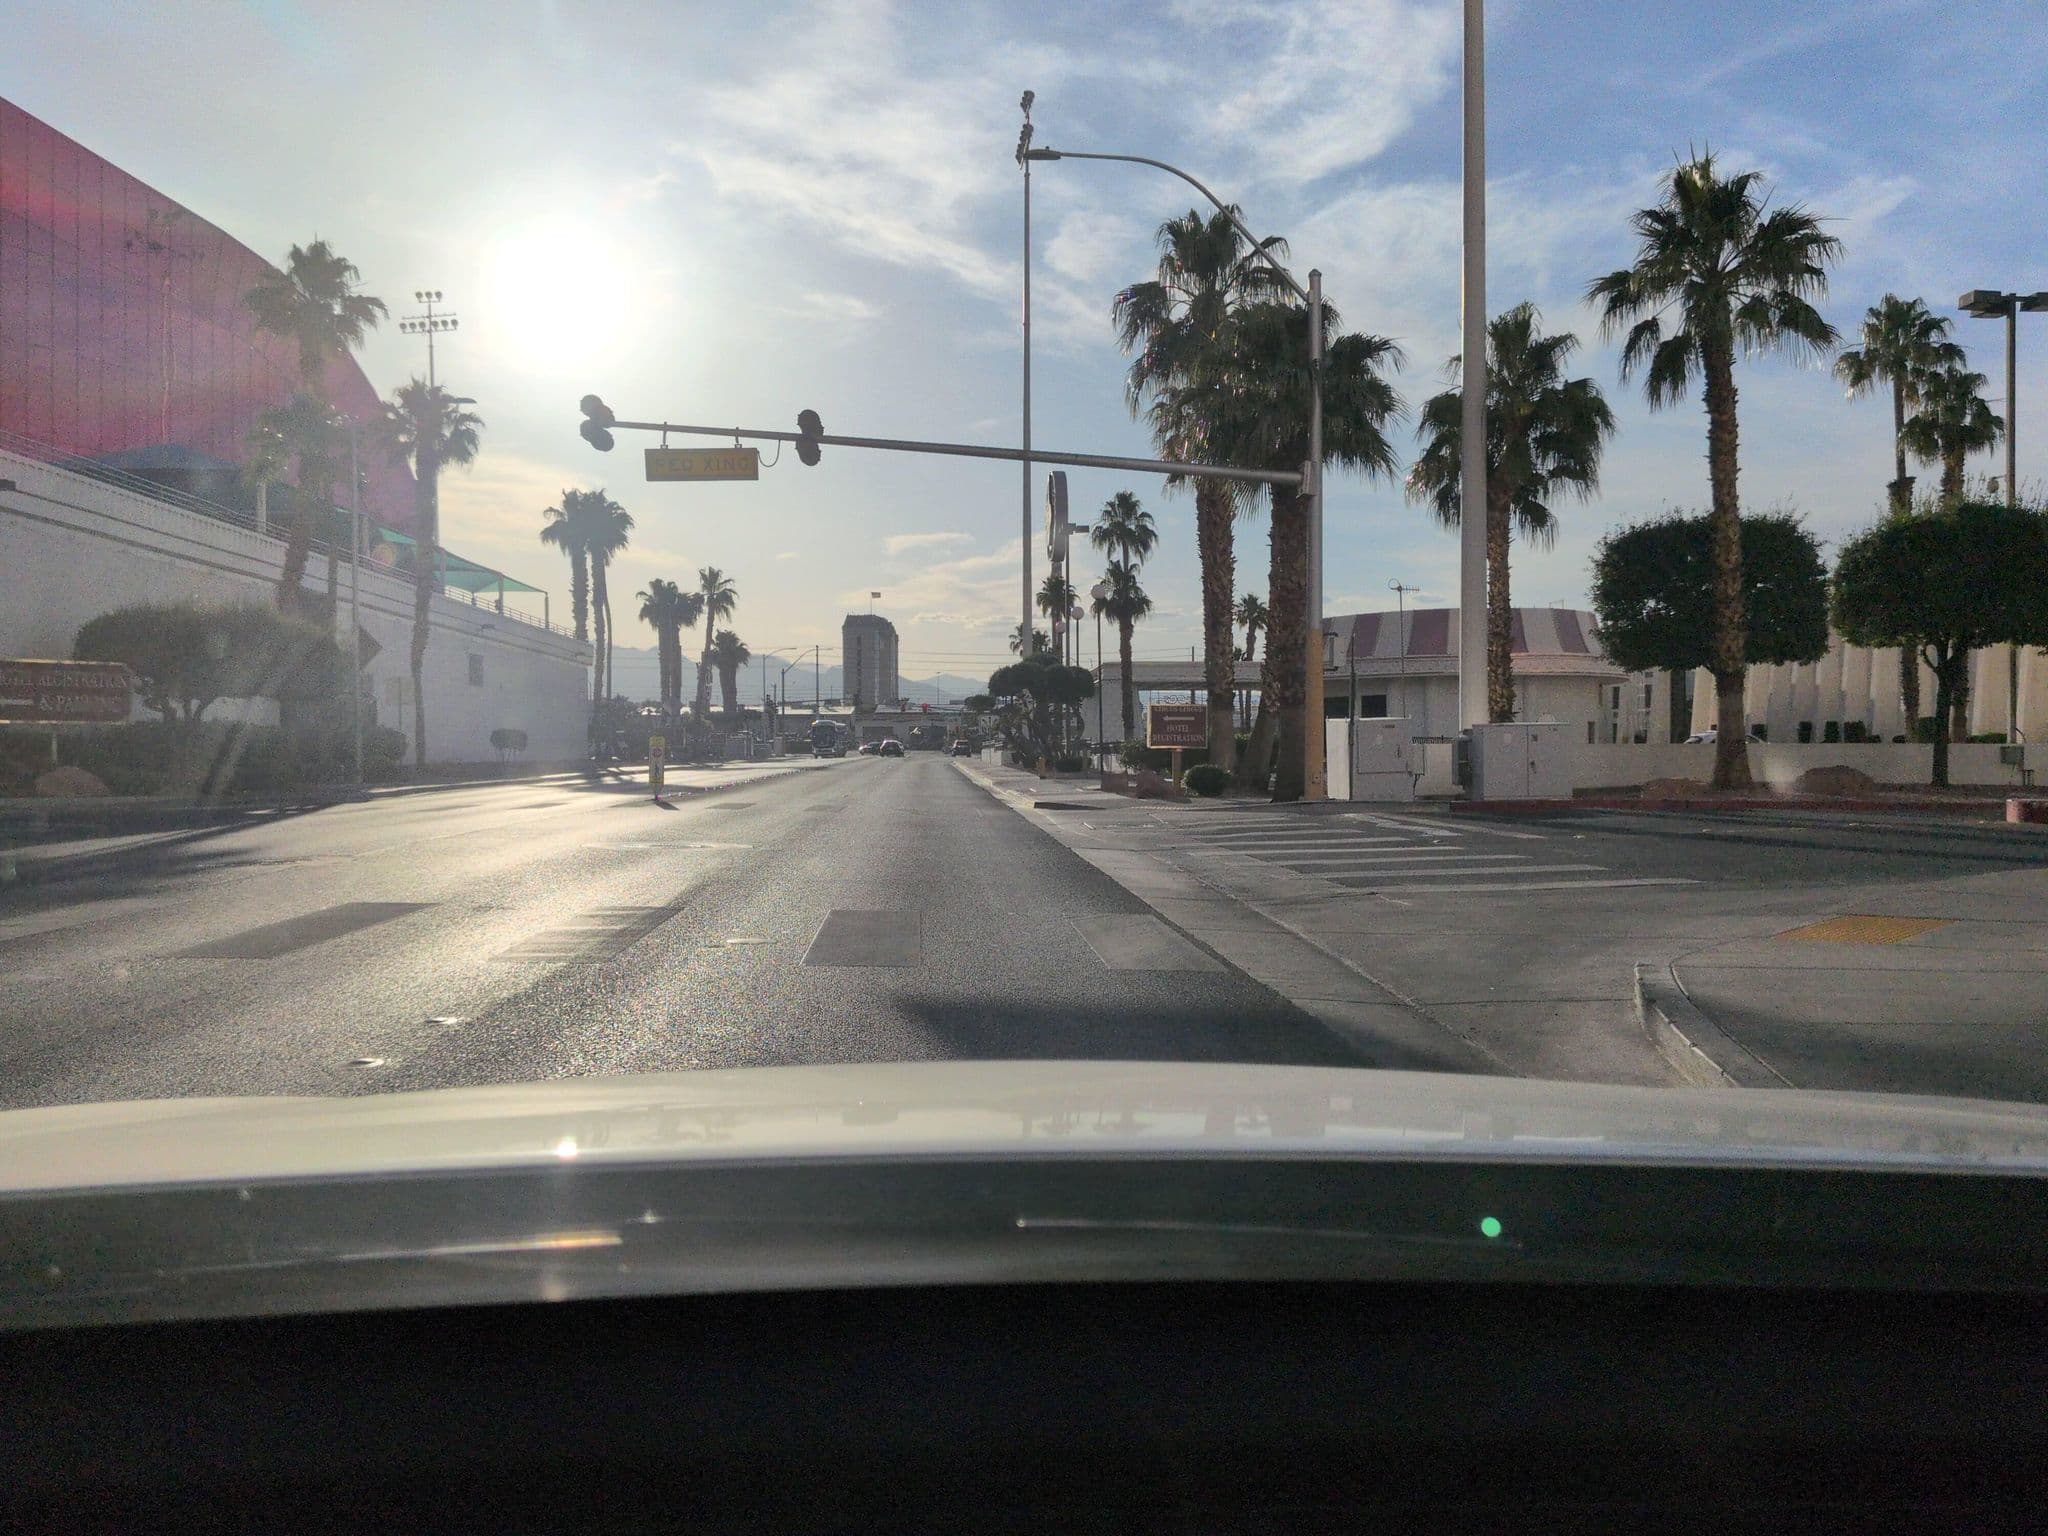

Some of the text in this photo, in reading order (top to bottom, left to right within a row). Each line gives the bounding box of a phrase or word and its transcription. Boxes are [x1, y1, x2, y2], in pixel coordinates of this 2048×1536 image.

[655, 456, 750, 473] PED XING
[1166, 724, 1189, 732] HOTEL
[1152, 734, 1204, 743] REGISTRATION
